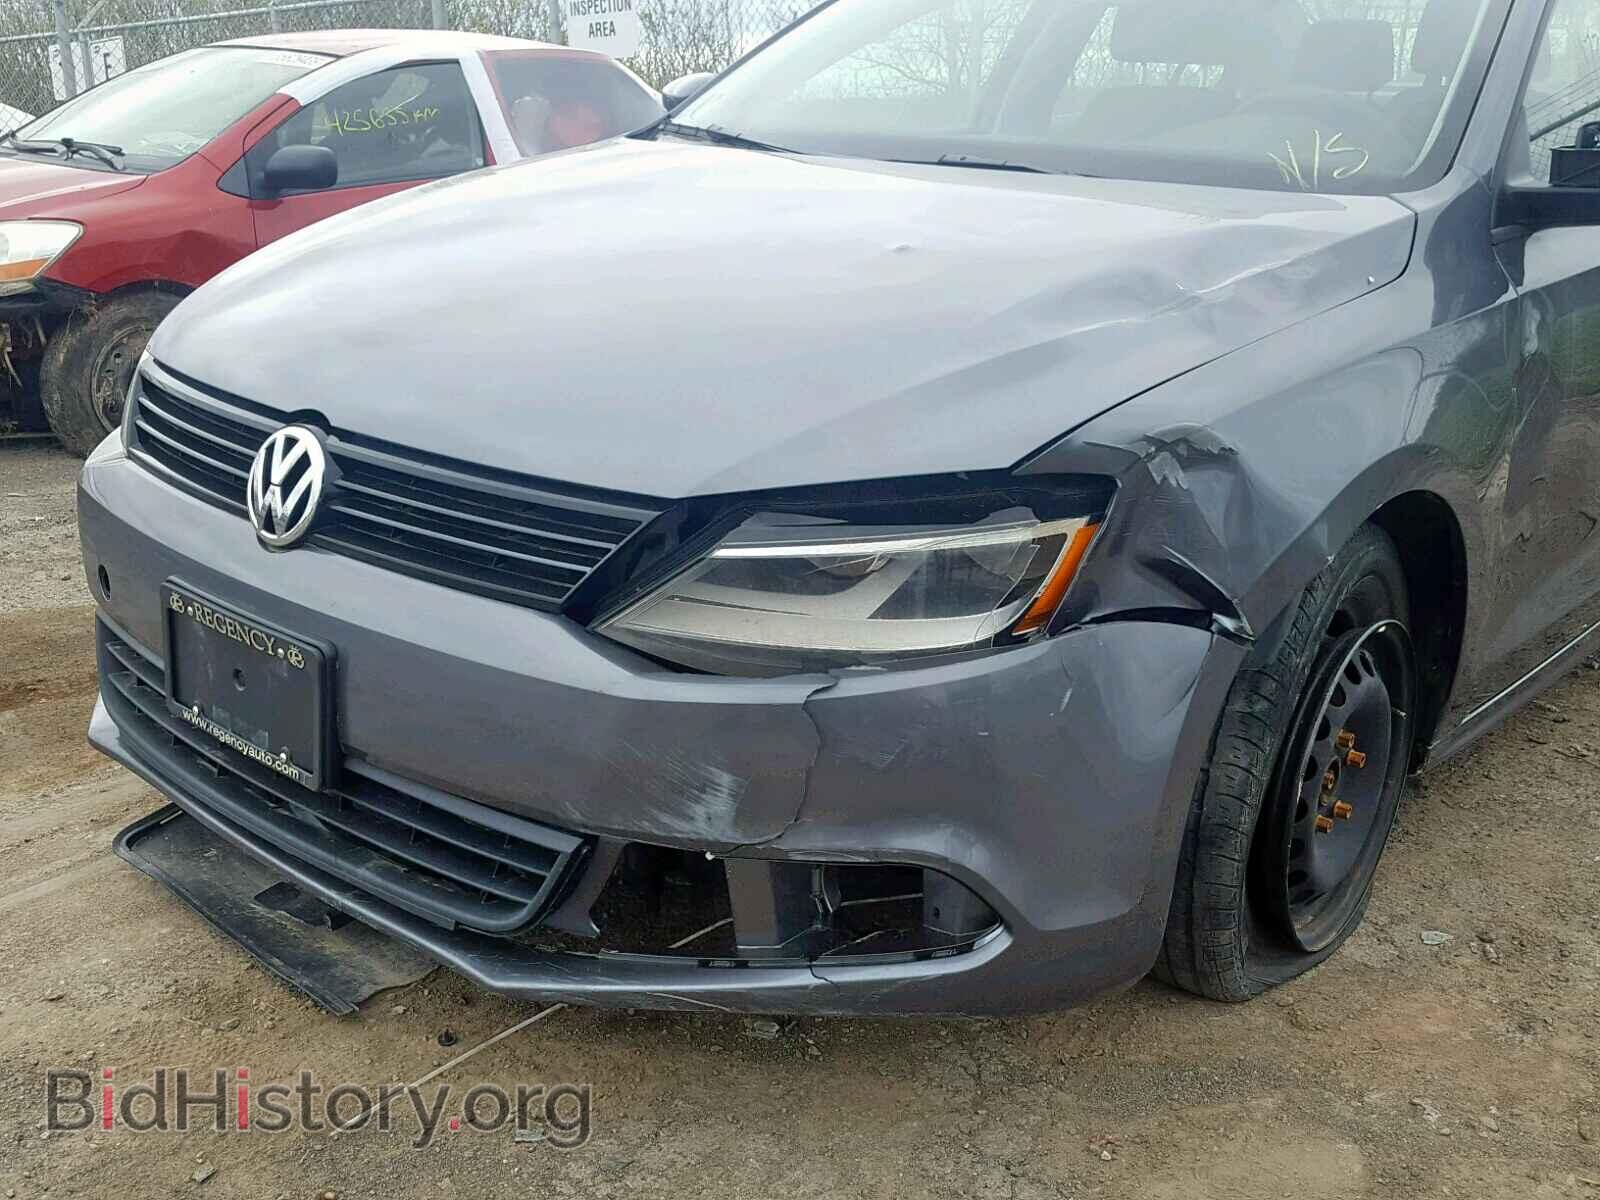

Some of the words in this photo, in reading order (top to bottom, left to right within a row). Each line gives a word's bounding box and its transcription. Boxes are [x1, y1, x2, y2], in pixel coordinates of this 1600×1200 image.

[569, 0, 632, 16] INSPECTION
[588, 20, 616, 38] AREA
[181, 709, 300, 781] www.regencyauto.com
